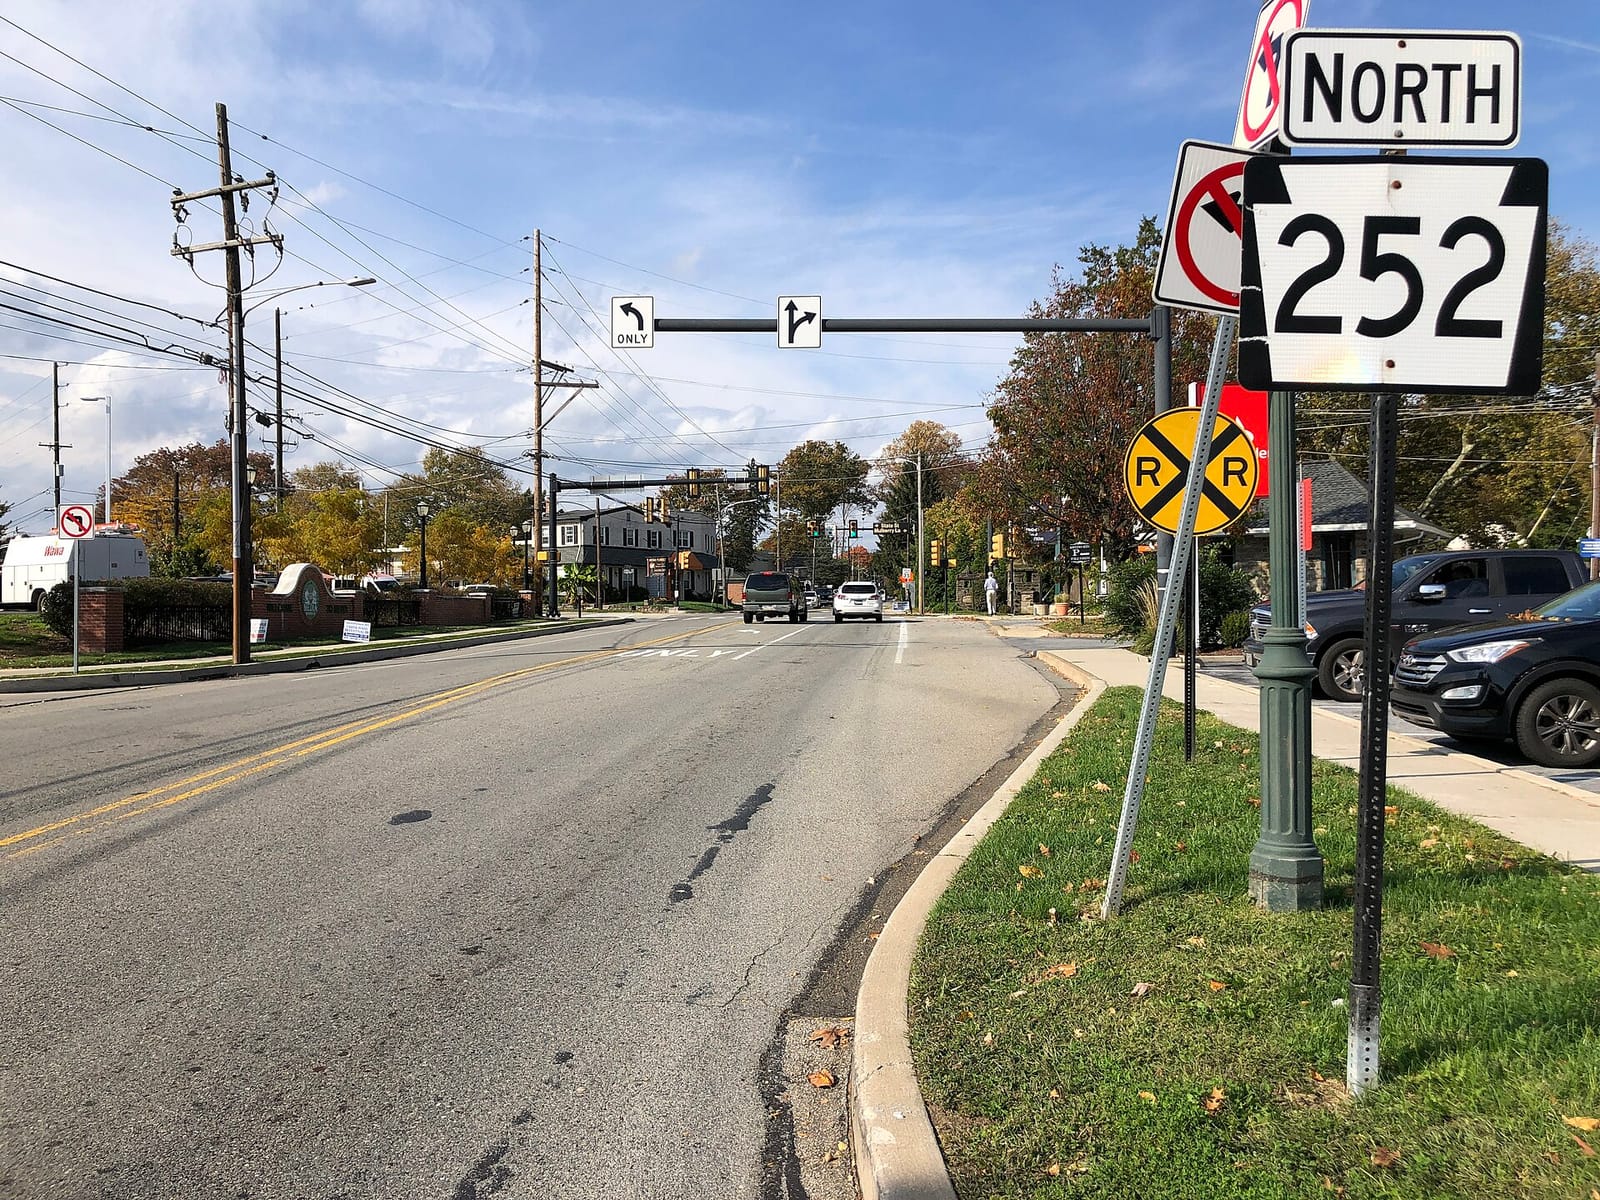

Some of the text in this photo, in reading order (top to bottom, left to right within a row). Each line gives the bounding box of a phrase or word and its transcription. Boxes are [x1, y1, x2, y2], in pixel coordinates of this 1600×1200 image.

[1302, 52, 1501, 124] NORTH
[1274, 213, 1506, 339] 252
[617, 333, 648, 344] ONLY
[1135, 456, 1248, 487] R R
[44, 545, 64, 556] Wawa
